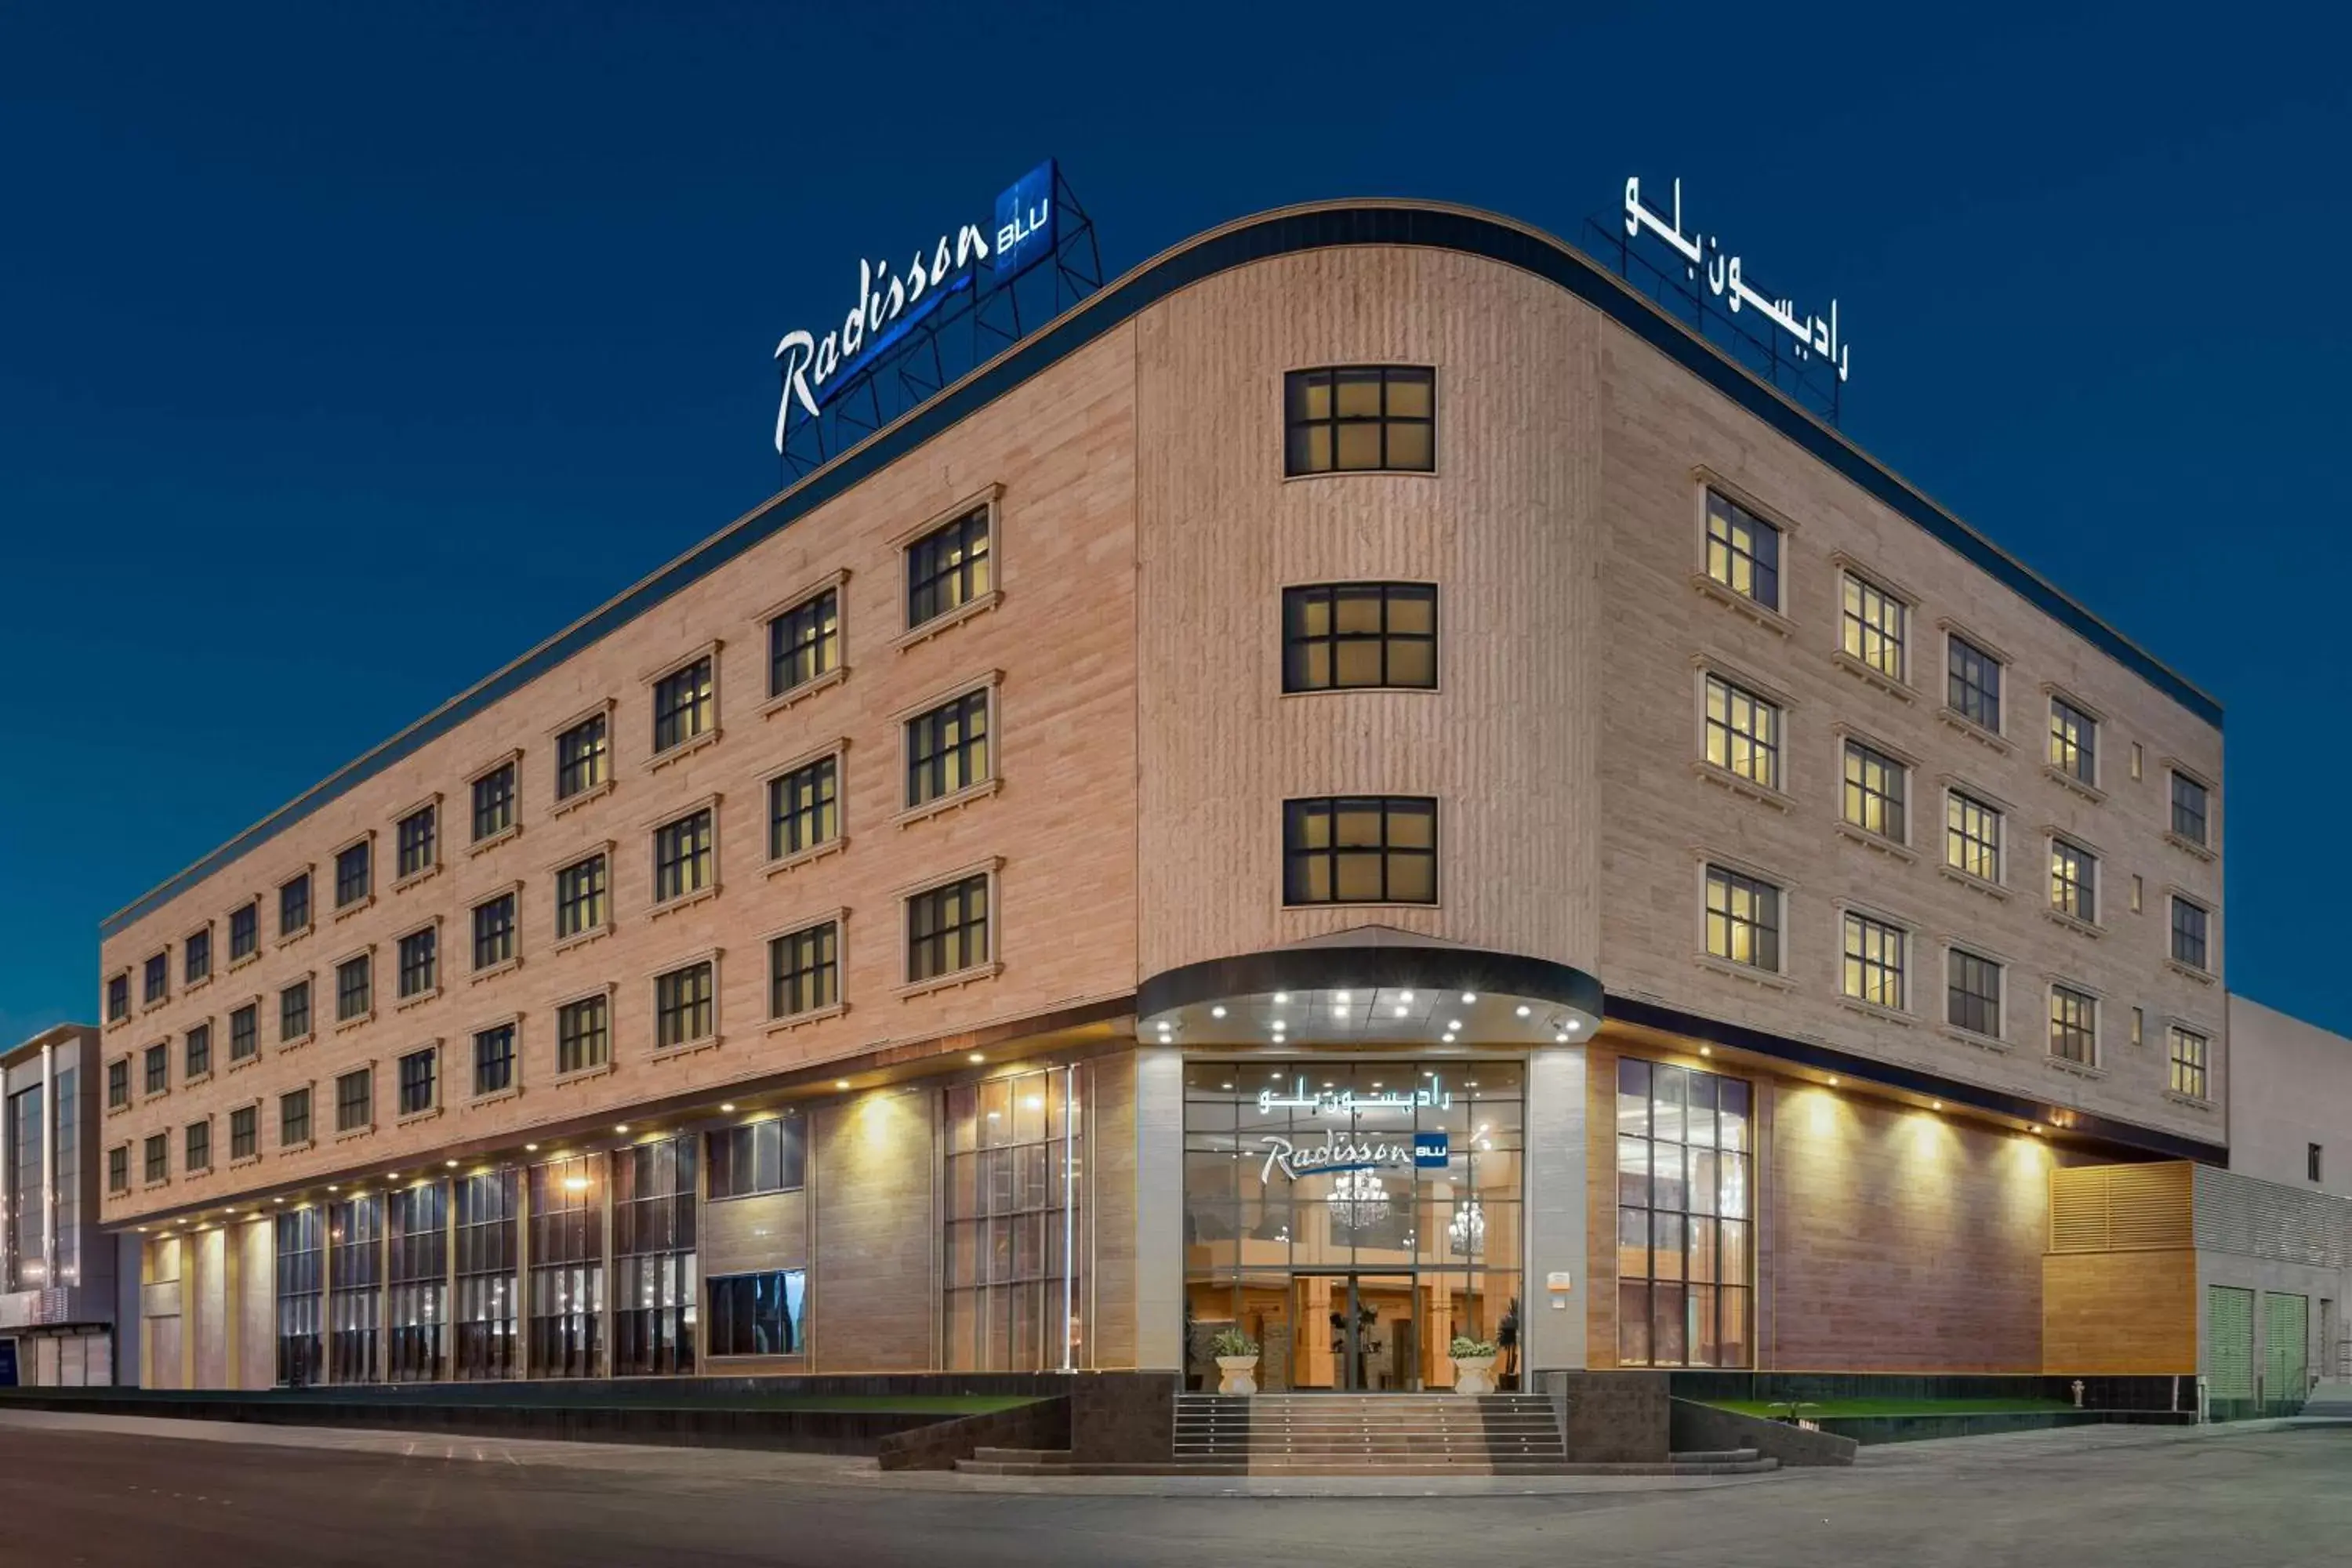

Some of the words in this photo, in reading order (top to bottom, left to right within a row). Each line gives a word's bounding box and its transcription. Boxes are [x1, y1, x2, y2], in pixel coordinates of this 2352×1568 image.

[1625, 176, 1702, 280] بلو
[774, 224, 989, 455] Radisson
[996, 198, 1048, 255] BLU
[1708, 236, 1849, 382] راديسون
[1259, 1075, 1321, 1115] بلو
[1324, 1075, 1450, 1114] راديسون
[1261, 1129, 1411, 1185] Radisson
[1415, 1145, 1446, 1157] BLU
